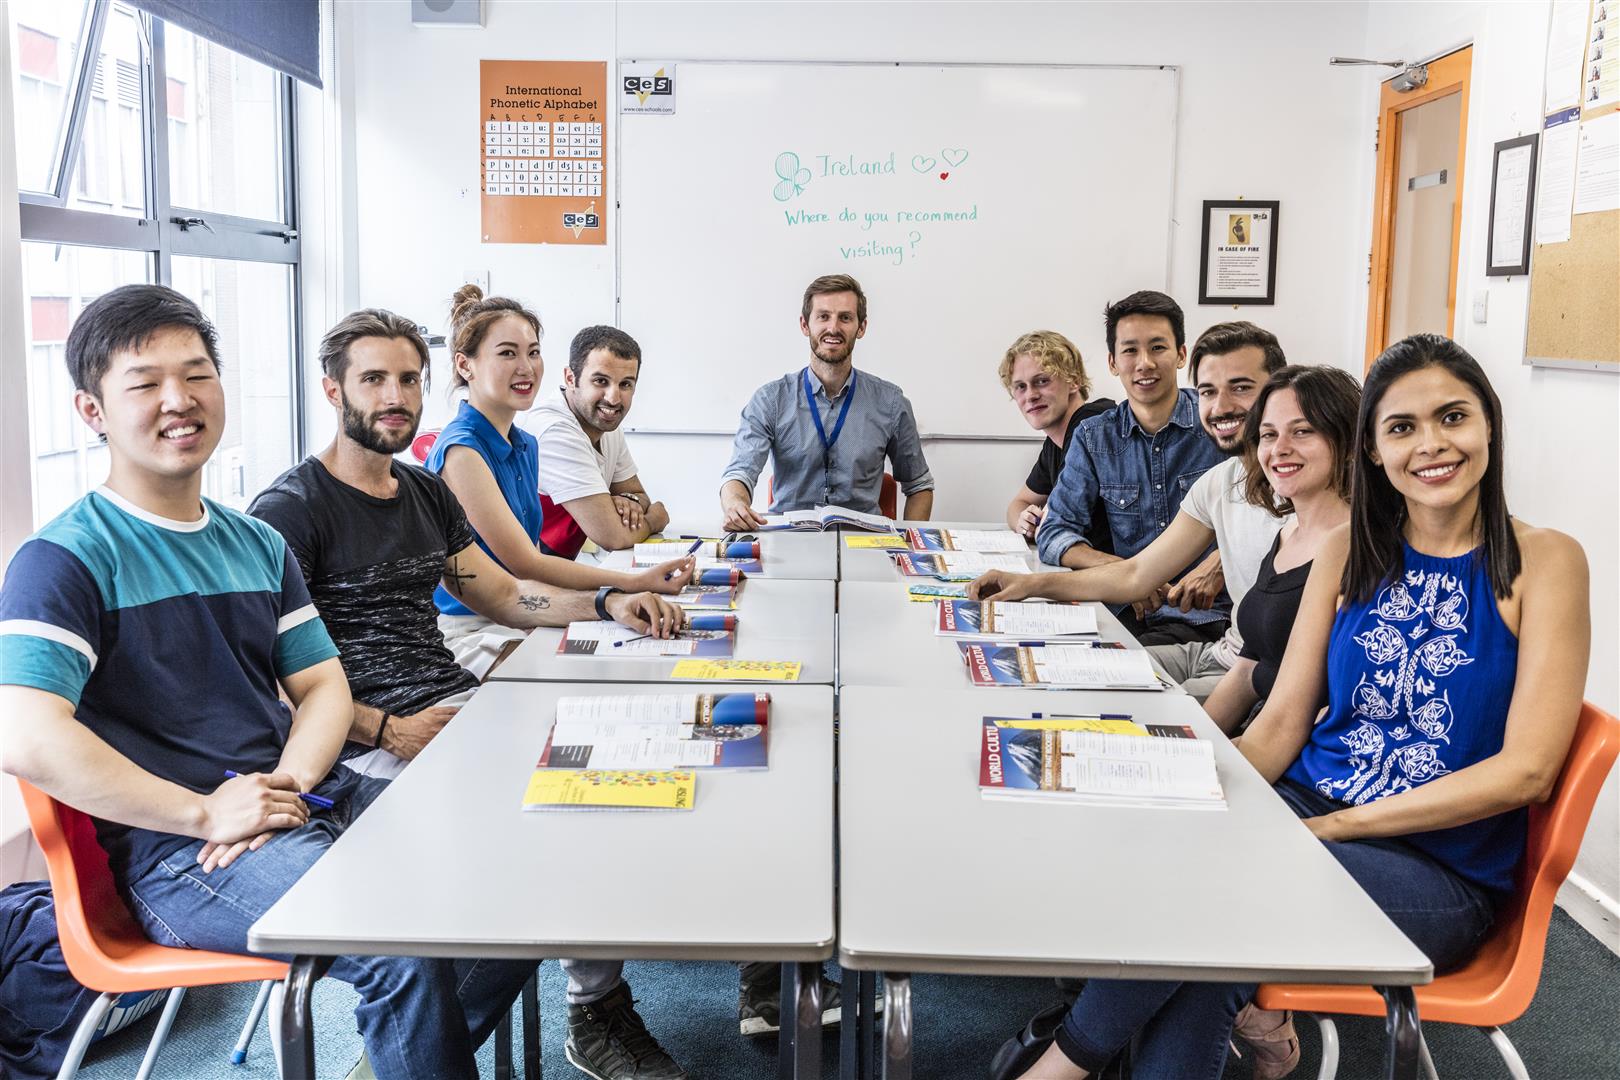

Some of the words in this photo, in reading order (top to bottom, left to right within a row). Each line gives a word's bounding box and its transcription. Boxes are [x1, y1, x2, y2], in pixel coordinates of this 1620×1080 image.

[505, 85, 582, 96] International
[490, 99, 541, 109] Phonetic
[543, 99, 598, 110] Alphabet
[816, 152, 896, 177] Ireland
[785, 209, 830, 226] Where
[839, 207, 857, 222] do
[864, 209, 889, 231] you
[897, 204, 977, 223] recommend
[945, 614, 956, 630] WORLD
[977, 664, 993, 682] WORLD
[702, 703, 711, 722] WORLD
[988, 753, 1002, 784] WORLD
